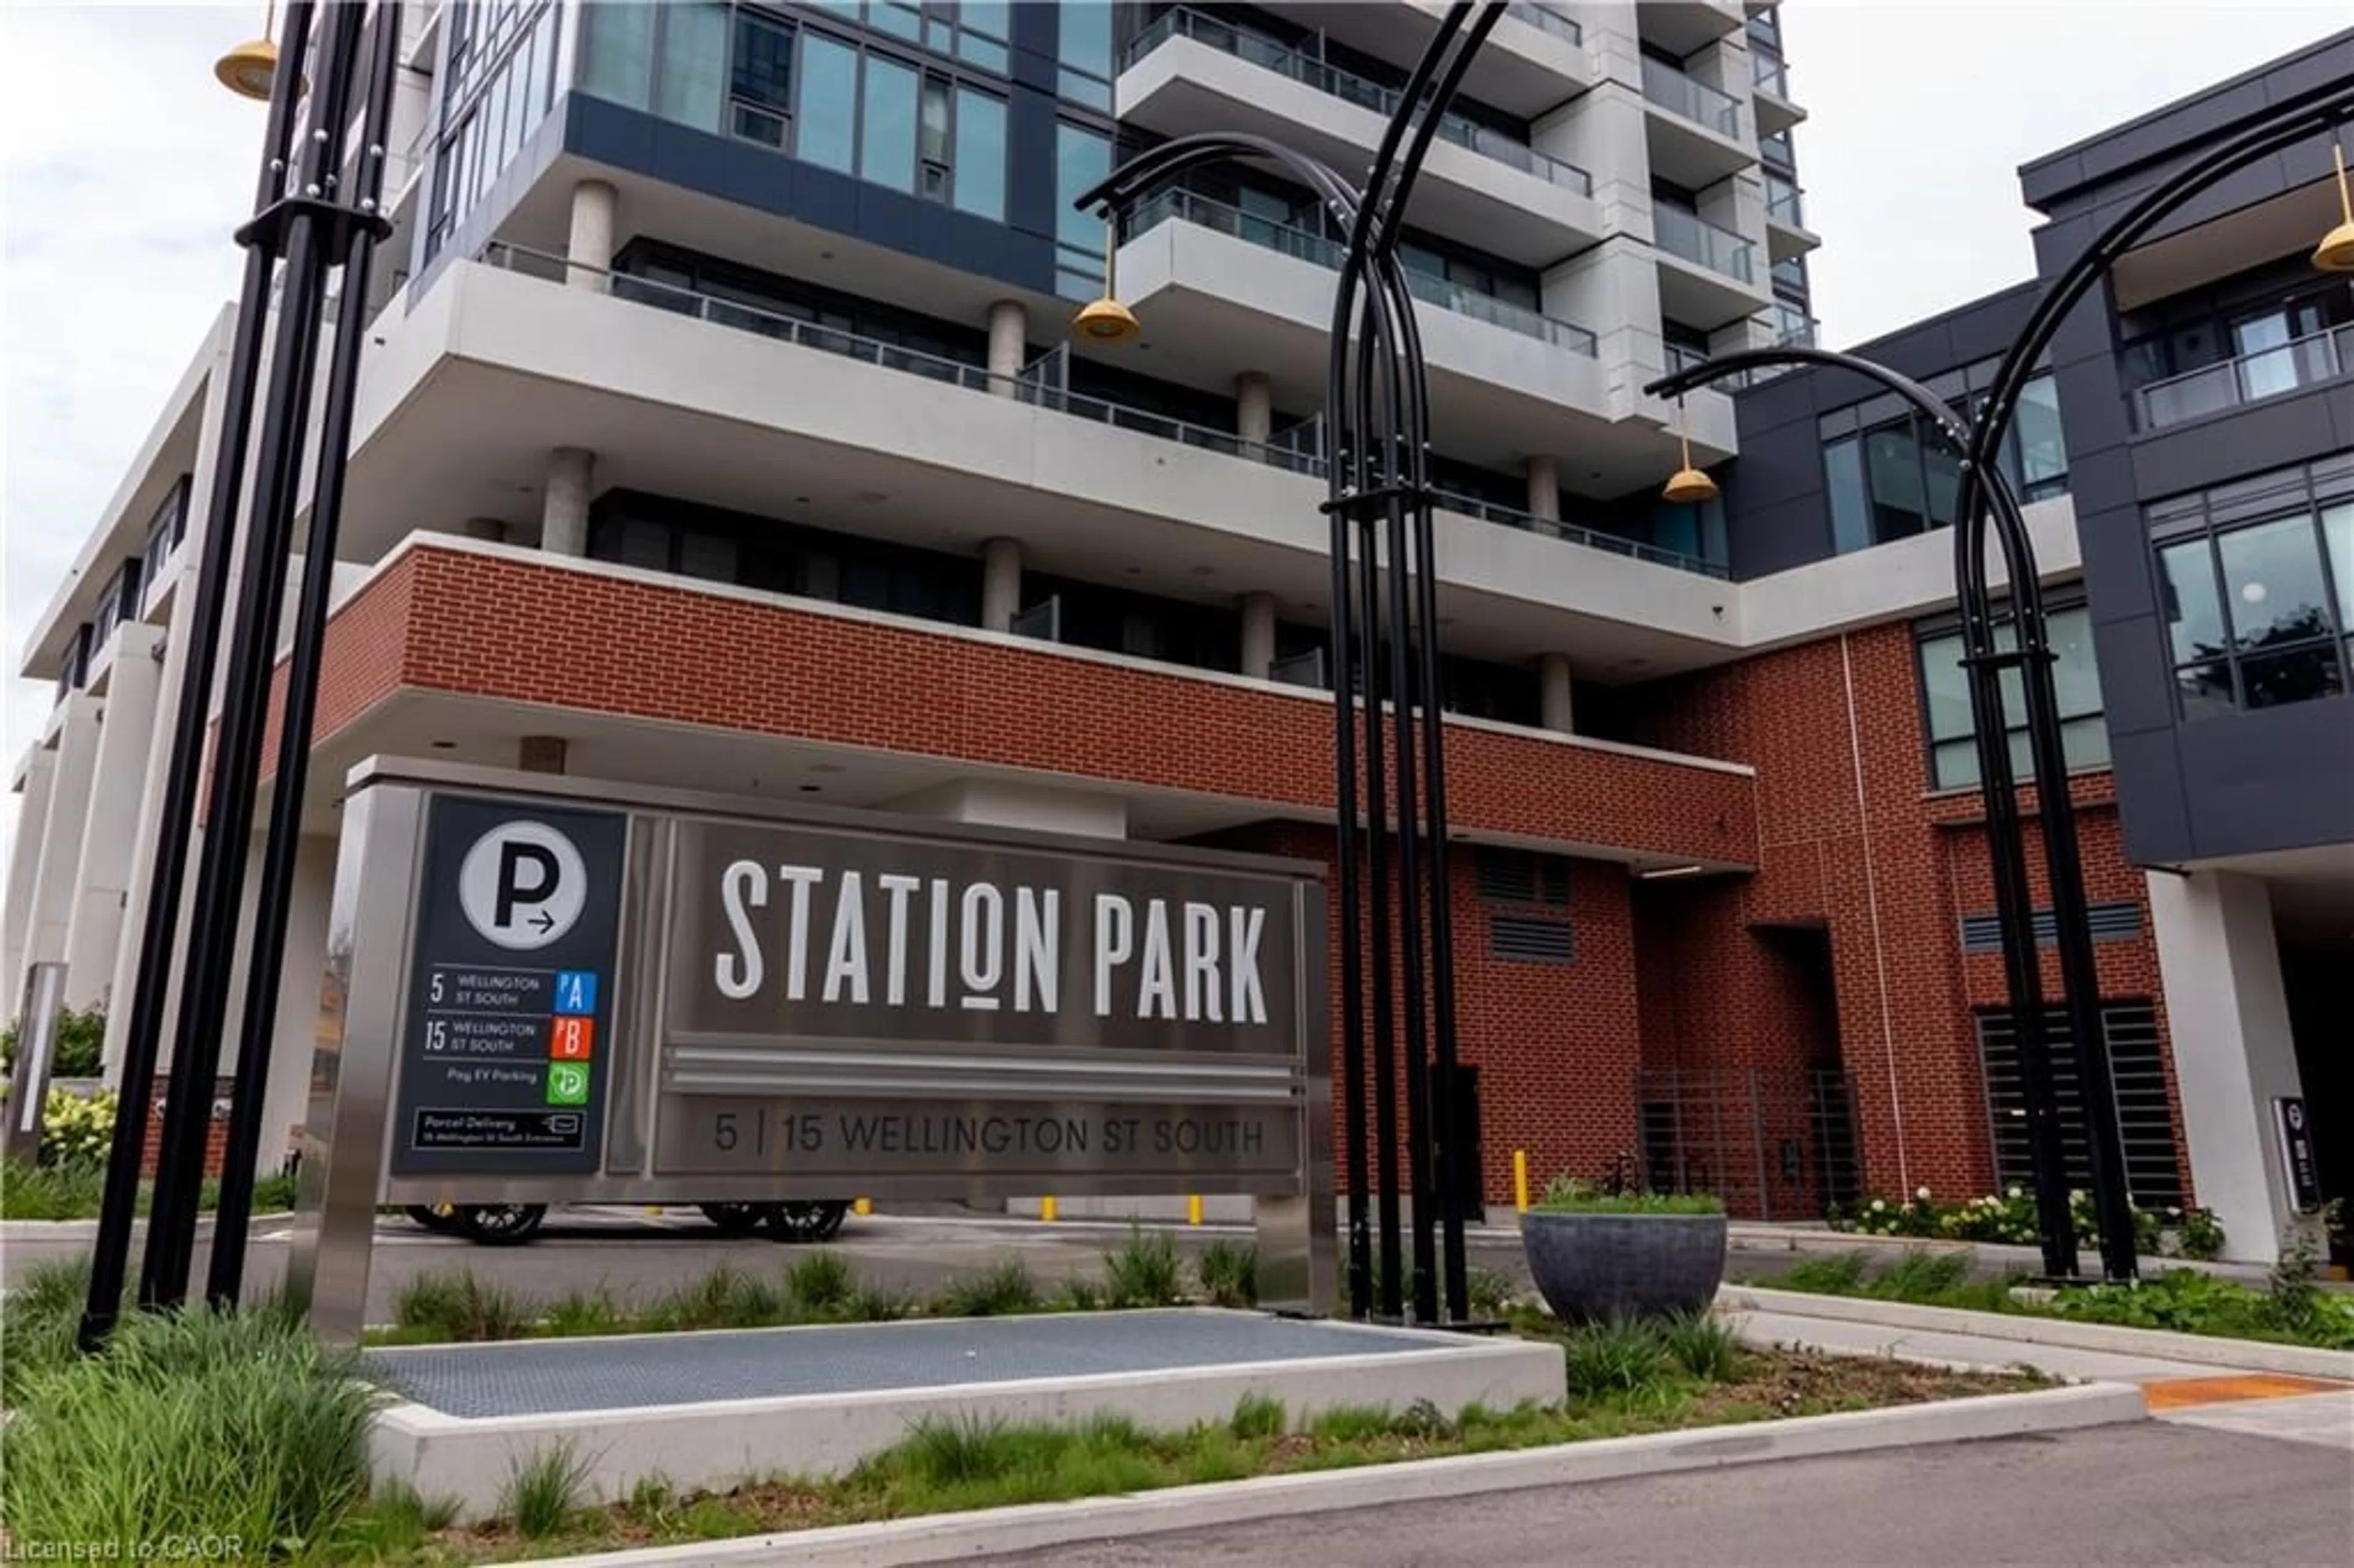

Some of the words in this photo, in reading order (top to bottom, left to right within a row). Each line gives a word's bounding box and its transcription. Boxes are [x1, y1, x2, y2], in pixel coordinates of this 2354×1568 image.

[494, 840, 560, 928] P
[715, 860, 1059, 1012] STATION
[1094, 893, 1267, 1024] PARK
[430, 973, 444, 1003] 5
[457, 973, 539, 991] WELLINGTON
[455, 991, 470, 1004] ST
[473, 991, 519, 1006] SOUTH
[425, 1020, 446, 1051] 15
[452, 1021, 535, 1036] WELLINGTON
[450, 1038, 466, 1051] ST
[469, 1038, 514, 1052] SOUTH
[448, 1067, 472, 1083] Pay
[492, 1069, 538, 1086] Parking
[425, 1116, 463, 1128] Parcel
[466, 1116, 516, 1132] Delivery
[715, 1114, 737, 1151] 5
[782, 1114, 823, 1152] 15
[839, 1116, 1088, 1154] WELLINGTON
[1103, 1119, 1141, 1153] ST
[1154, 1120, 1263, 1154] SOUTH
